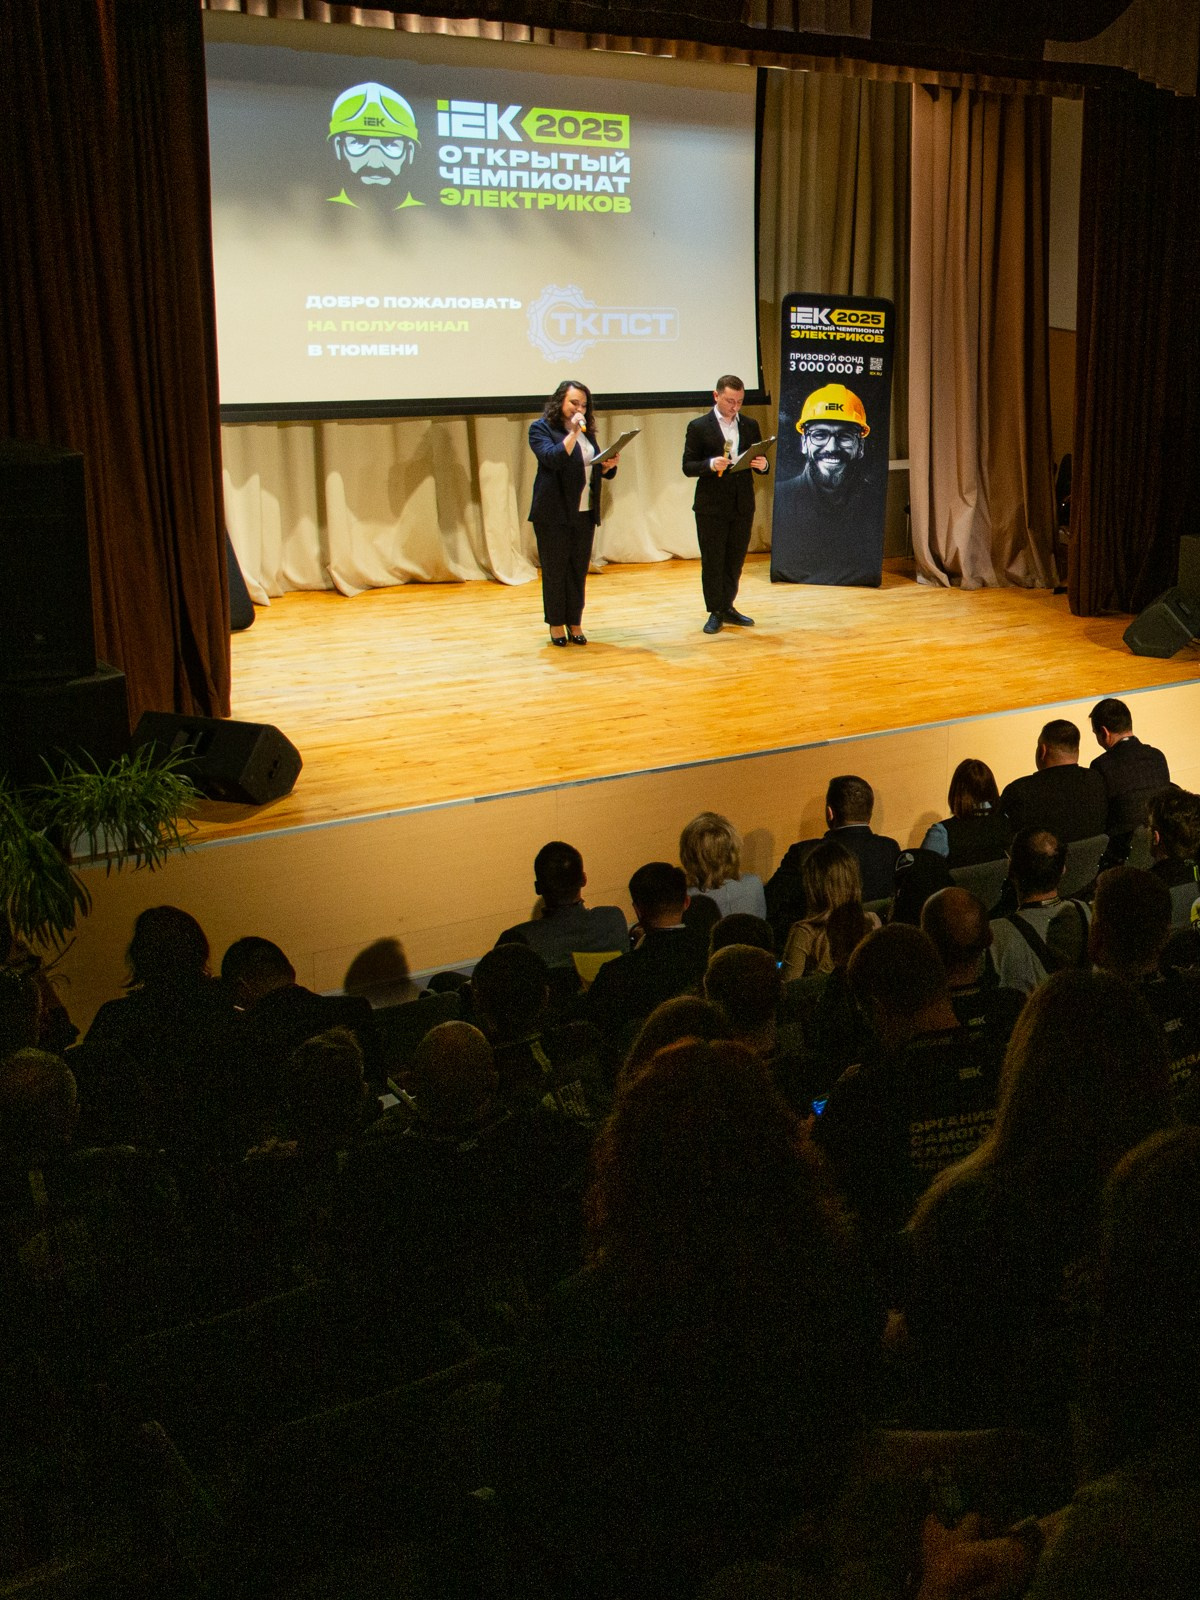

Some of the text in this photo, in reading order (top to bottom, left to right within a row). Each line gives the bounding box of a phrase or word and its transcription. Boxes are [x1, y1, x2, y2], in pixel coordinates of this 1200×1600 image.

[535, 114, 624, 142] 2025
[438, 145, 632, 175] ОТКРЫТЫЙ
[439, 166, 631, 194] ЧЕМПИОНАТ
[439, 187, 632, 215] ЭЛЕКТРИКОВ
[305, 295, 523, 311] ДОБРО ПОЖАЛОВАТЬ
[550, 312, 675, 337] ТКПСТ
[836, 311, 882, 325] 2025
[307, 319, 470, 333] НА ПОЛУФИНАЛ
[790, 324, 885, 335] ОТКРЫТЫЙ ЧЕМПИОНАТ
[790, 330, 885, 344] ЭЛЕКТРИКОВ
[307, 343, 419, 357] В ТЮМЕНИ
[790, 352, 864, 364] ПРИЗОВОЙ ФОНД
[789, 361, 796, 371] 3
[799, 361, 825, 372] 000
[827, 363, 853, 374] 000
